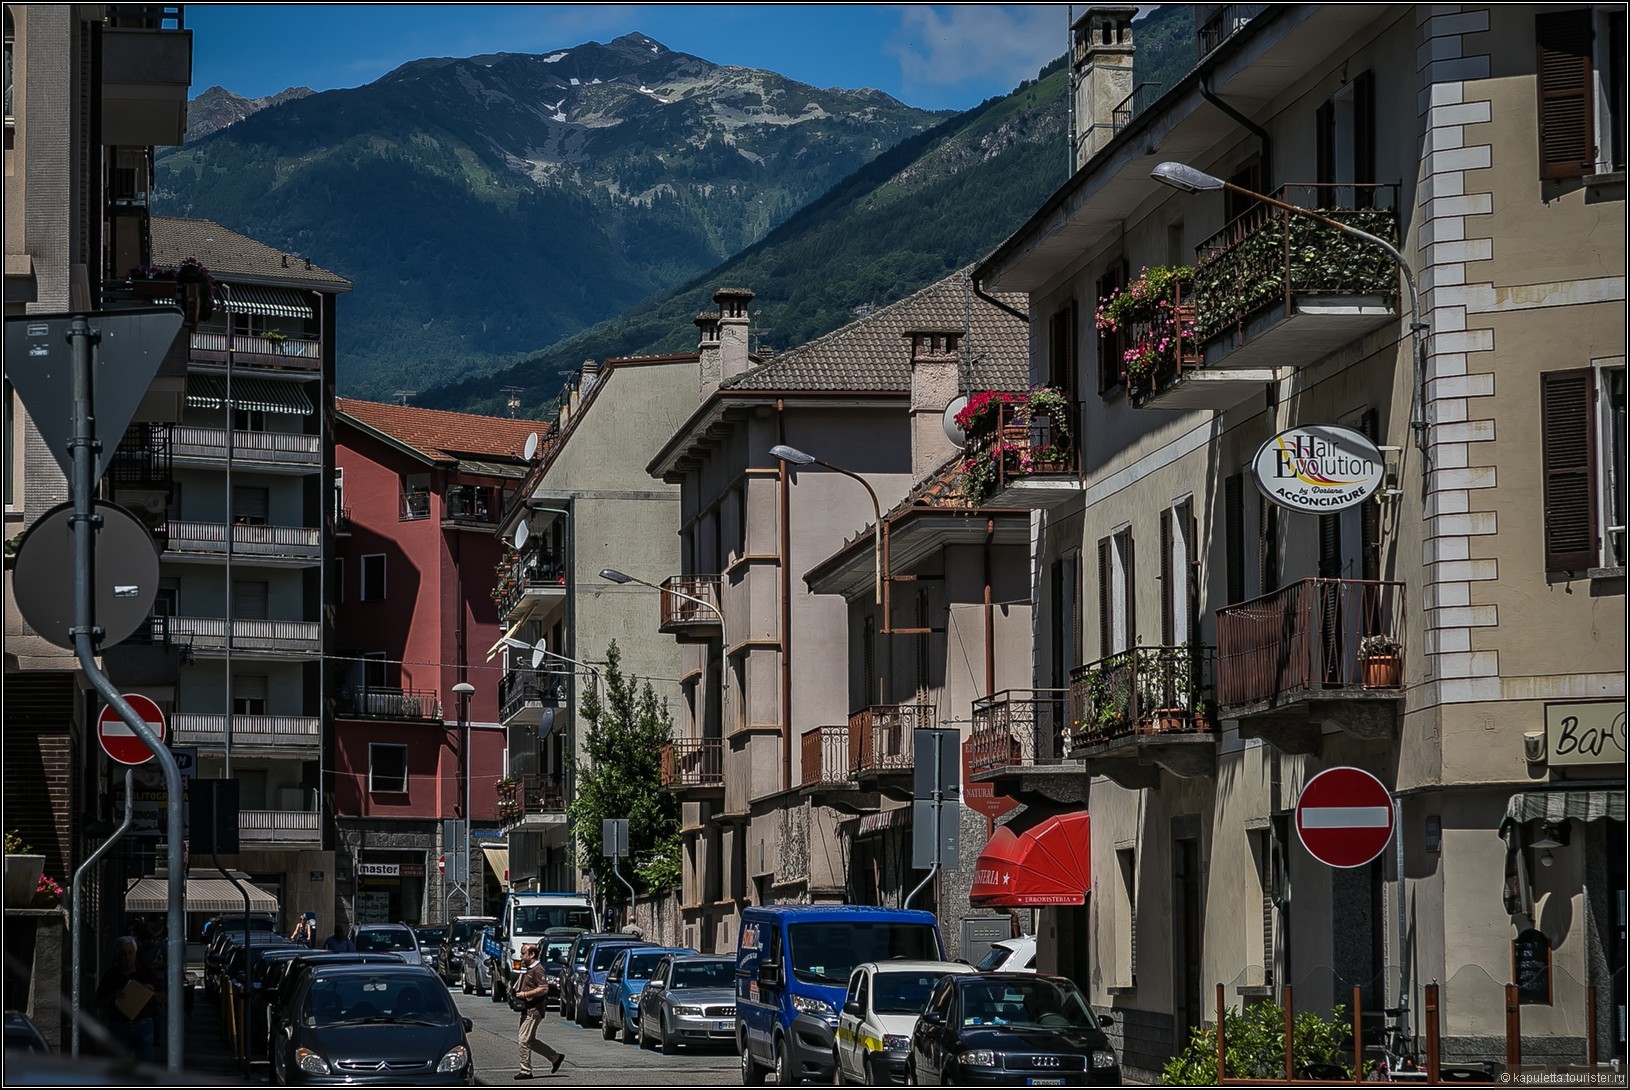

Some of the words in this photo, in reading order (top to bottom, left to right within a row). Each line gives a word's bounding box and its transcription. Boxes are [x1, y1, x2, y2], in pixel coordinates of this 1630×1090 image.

[1293, 434, 1340, 459] Hair
[1272, 448, 1374, 478] Evolution
[1276, 486, 1367, 507] ACCONCIATURE
[1299, 486, 1309, 494] by
[1311, 486, 1344, 494] Doriana
[359, 865, 398, 874] master
